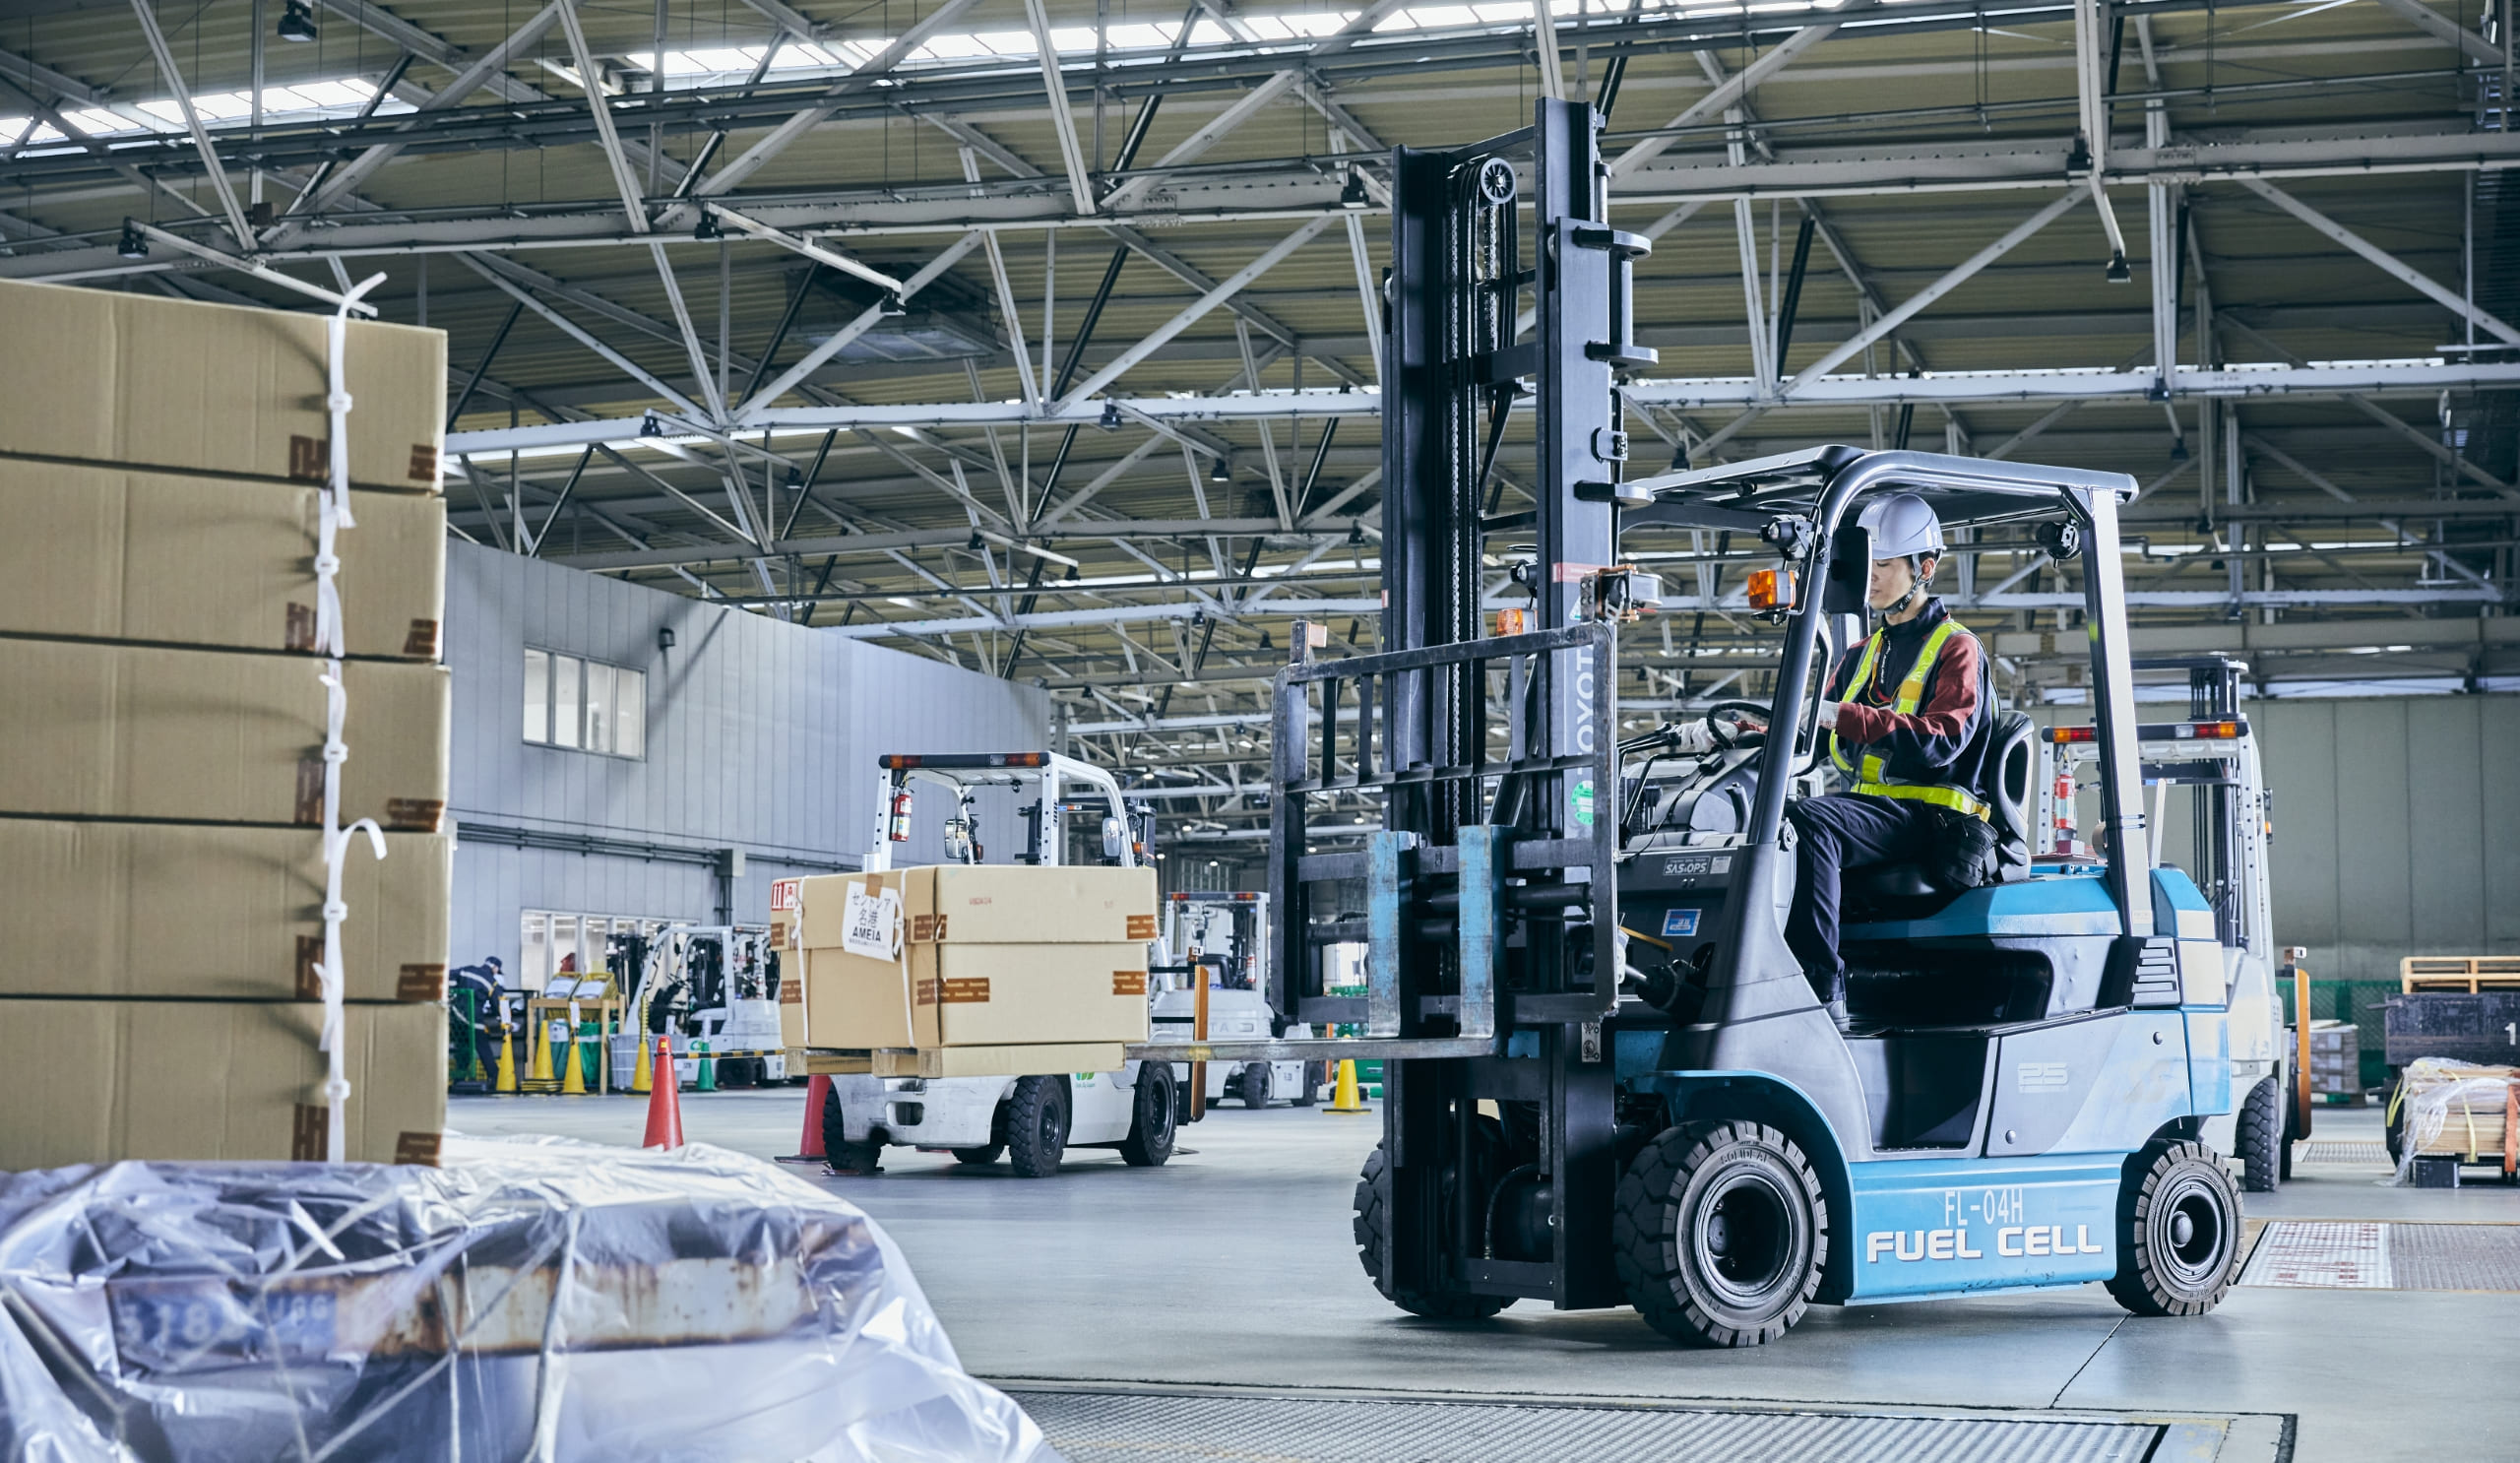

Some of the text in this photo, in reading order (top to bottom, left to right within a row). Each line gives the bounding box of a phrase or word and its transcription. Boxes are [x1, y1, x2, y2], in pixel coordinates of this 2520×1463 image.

[852, 925, 881, 941] AMEIA
[2018, 1063, 2068, 1086] 25
[1945, 1189, 2023, 1227] FL-04H
[1867, 1224, 2103, 1263] FUEL CELL
